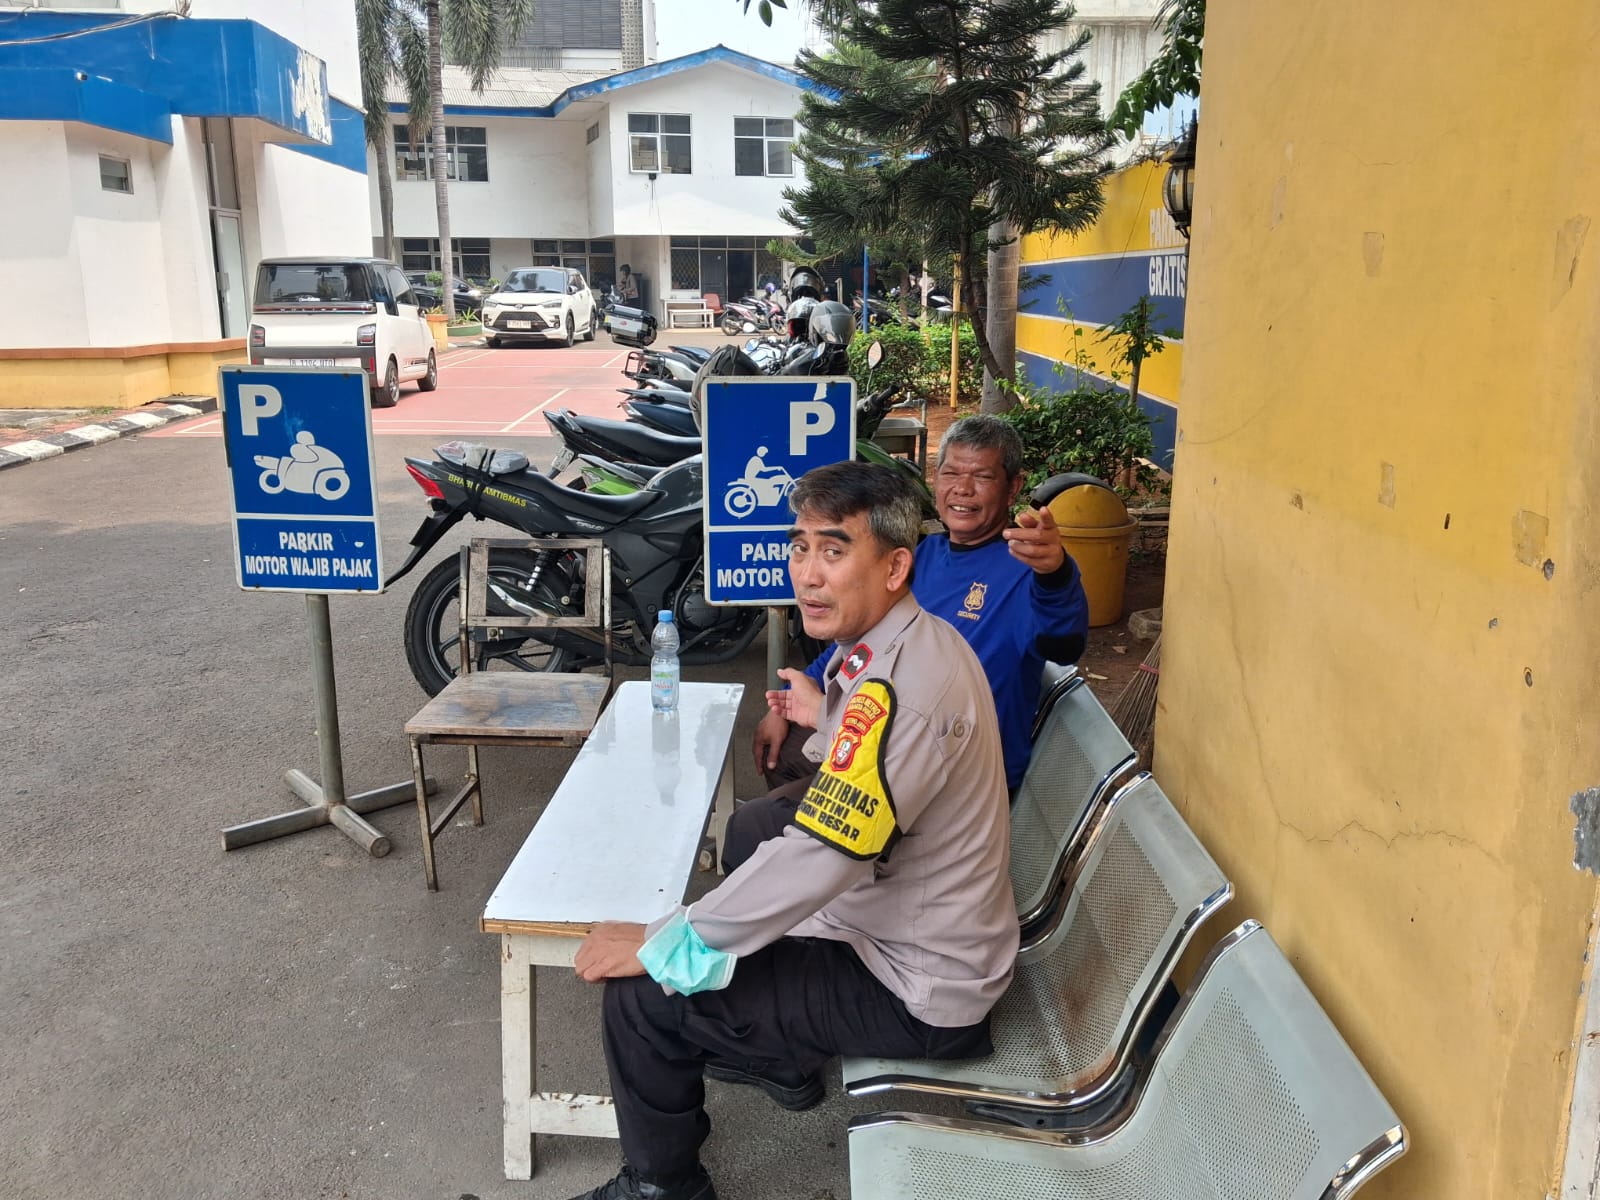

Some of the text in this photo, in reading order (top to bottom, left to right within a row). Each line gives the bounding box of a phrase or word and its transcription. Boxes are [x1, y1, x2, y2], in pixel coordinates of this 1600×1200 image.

[1149, 255, 1186, 298] GRATIS
[238, 384, 282, 437] P
[789, 401, 836, 456] P
[279, 532, 334, 552] PARKIR
[741, 543, 793, 562] PARK
[245, 556, 373, 578] MOTOR WAJIB PAJAK
[717, 568, 785, 588] MOTOR
[818, 811, 860, 841] BESAR
